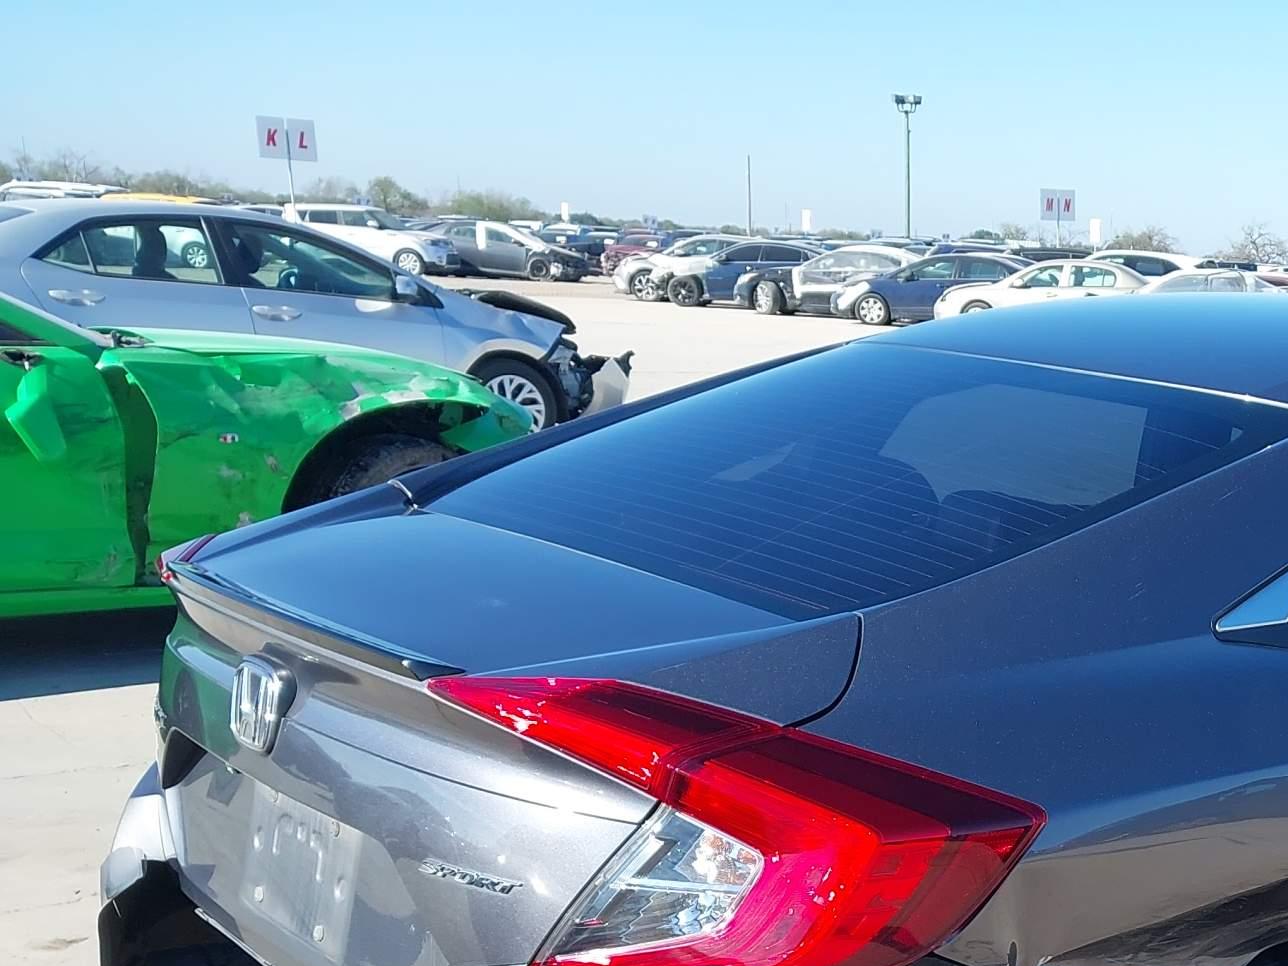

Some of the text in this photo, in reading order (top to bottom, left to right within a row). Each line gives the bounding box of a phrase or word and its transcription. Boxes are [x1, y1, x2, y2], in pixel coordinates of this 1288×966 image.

[266, 128, 308, 149] K L
[1046, 197, 1072, 212] M N
[417, 857, 523, 896] SPORT
